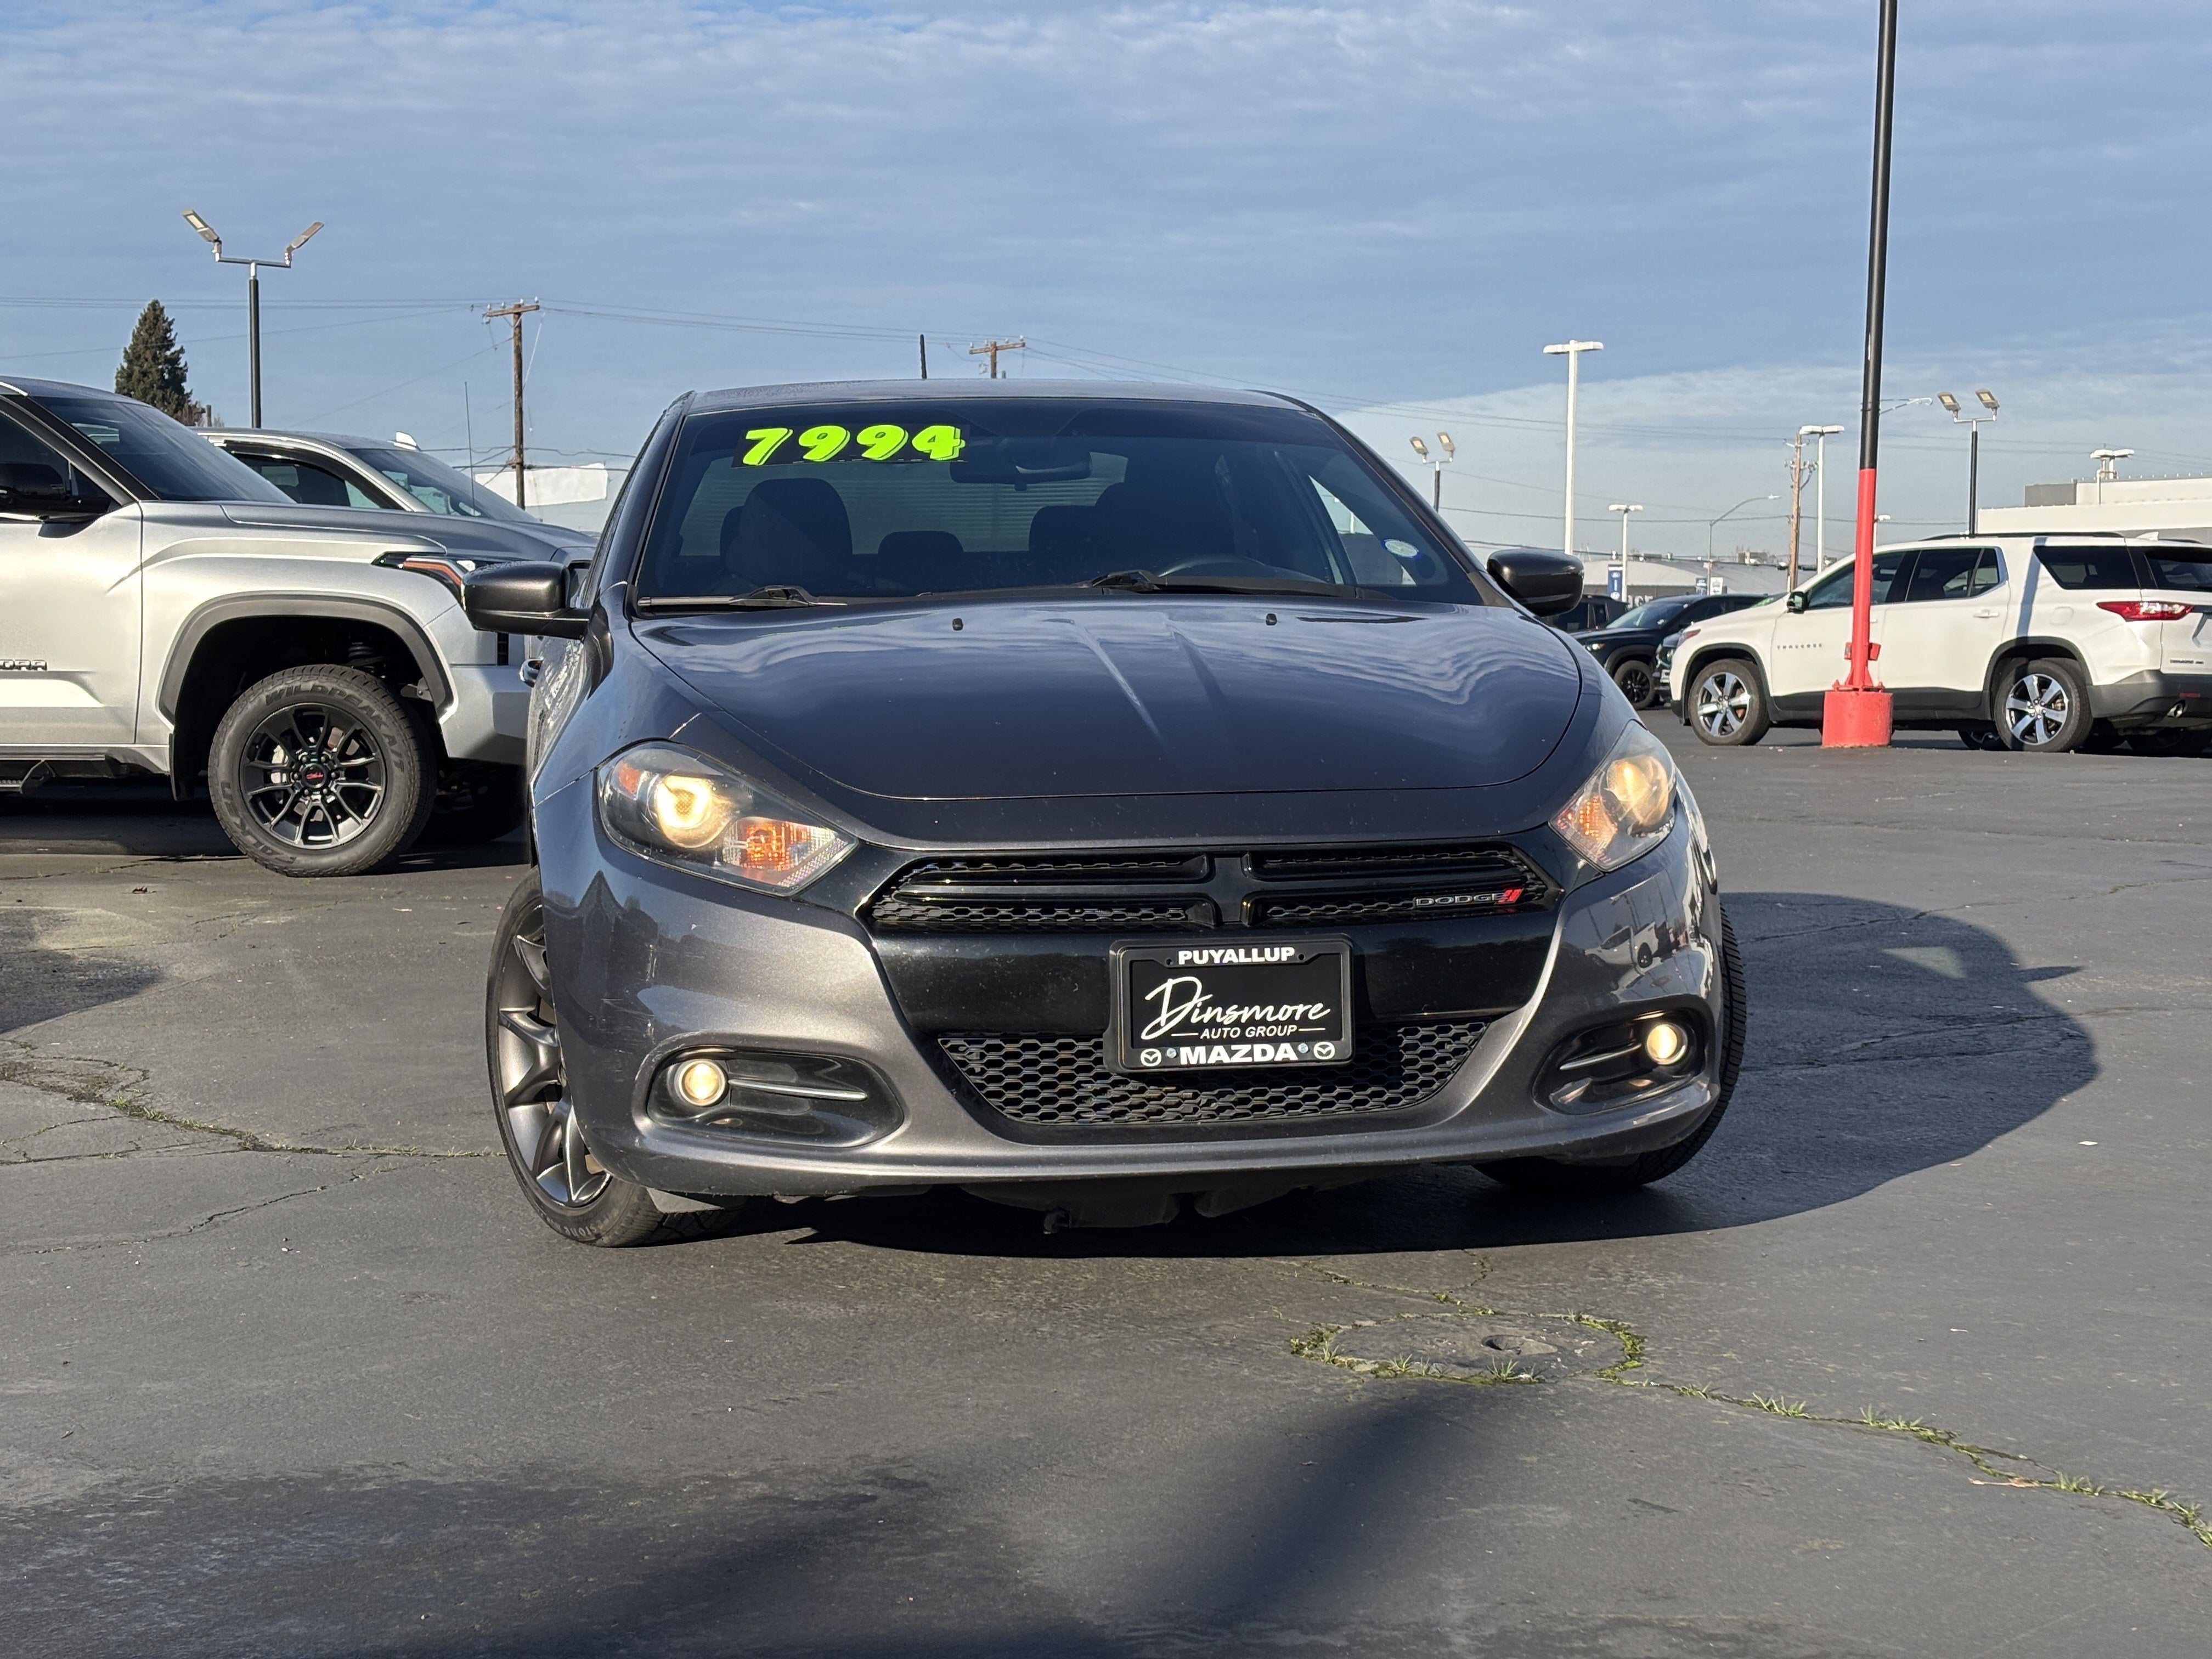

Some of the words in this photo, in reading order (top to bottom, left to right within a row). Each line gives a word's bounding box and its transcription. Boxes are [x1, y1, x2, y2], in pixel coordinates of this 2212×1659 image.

[743, 425, 966, 466] 7994
[1415, 893, 1507, 906] DODGE
[1178, 947, 1295, 966] PUYALLUP
[1141, 976, 1331, 1040] Dinsmore
[1200, 1027, 1240, 1040] AUTO
[1245, 1025, 1297, 1037] GROUP
[1180, 1042, 1299, 1065] MAZDA
